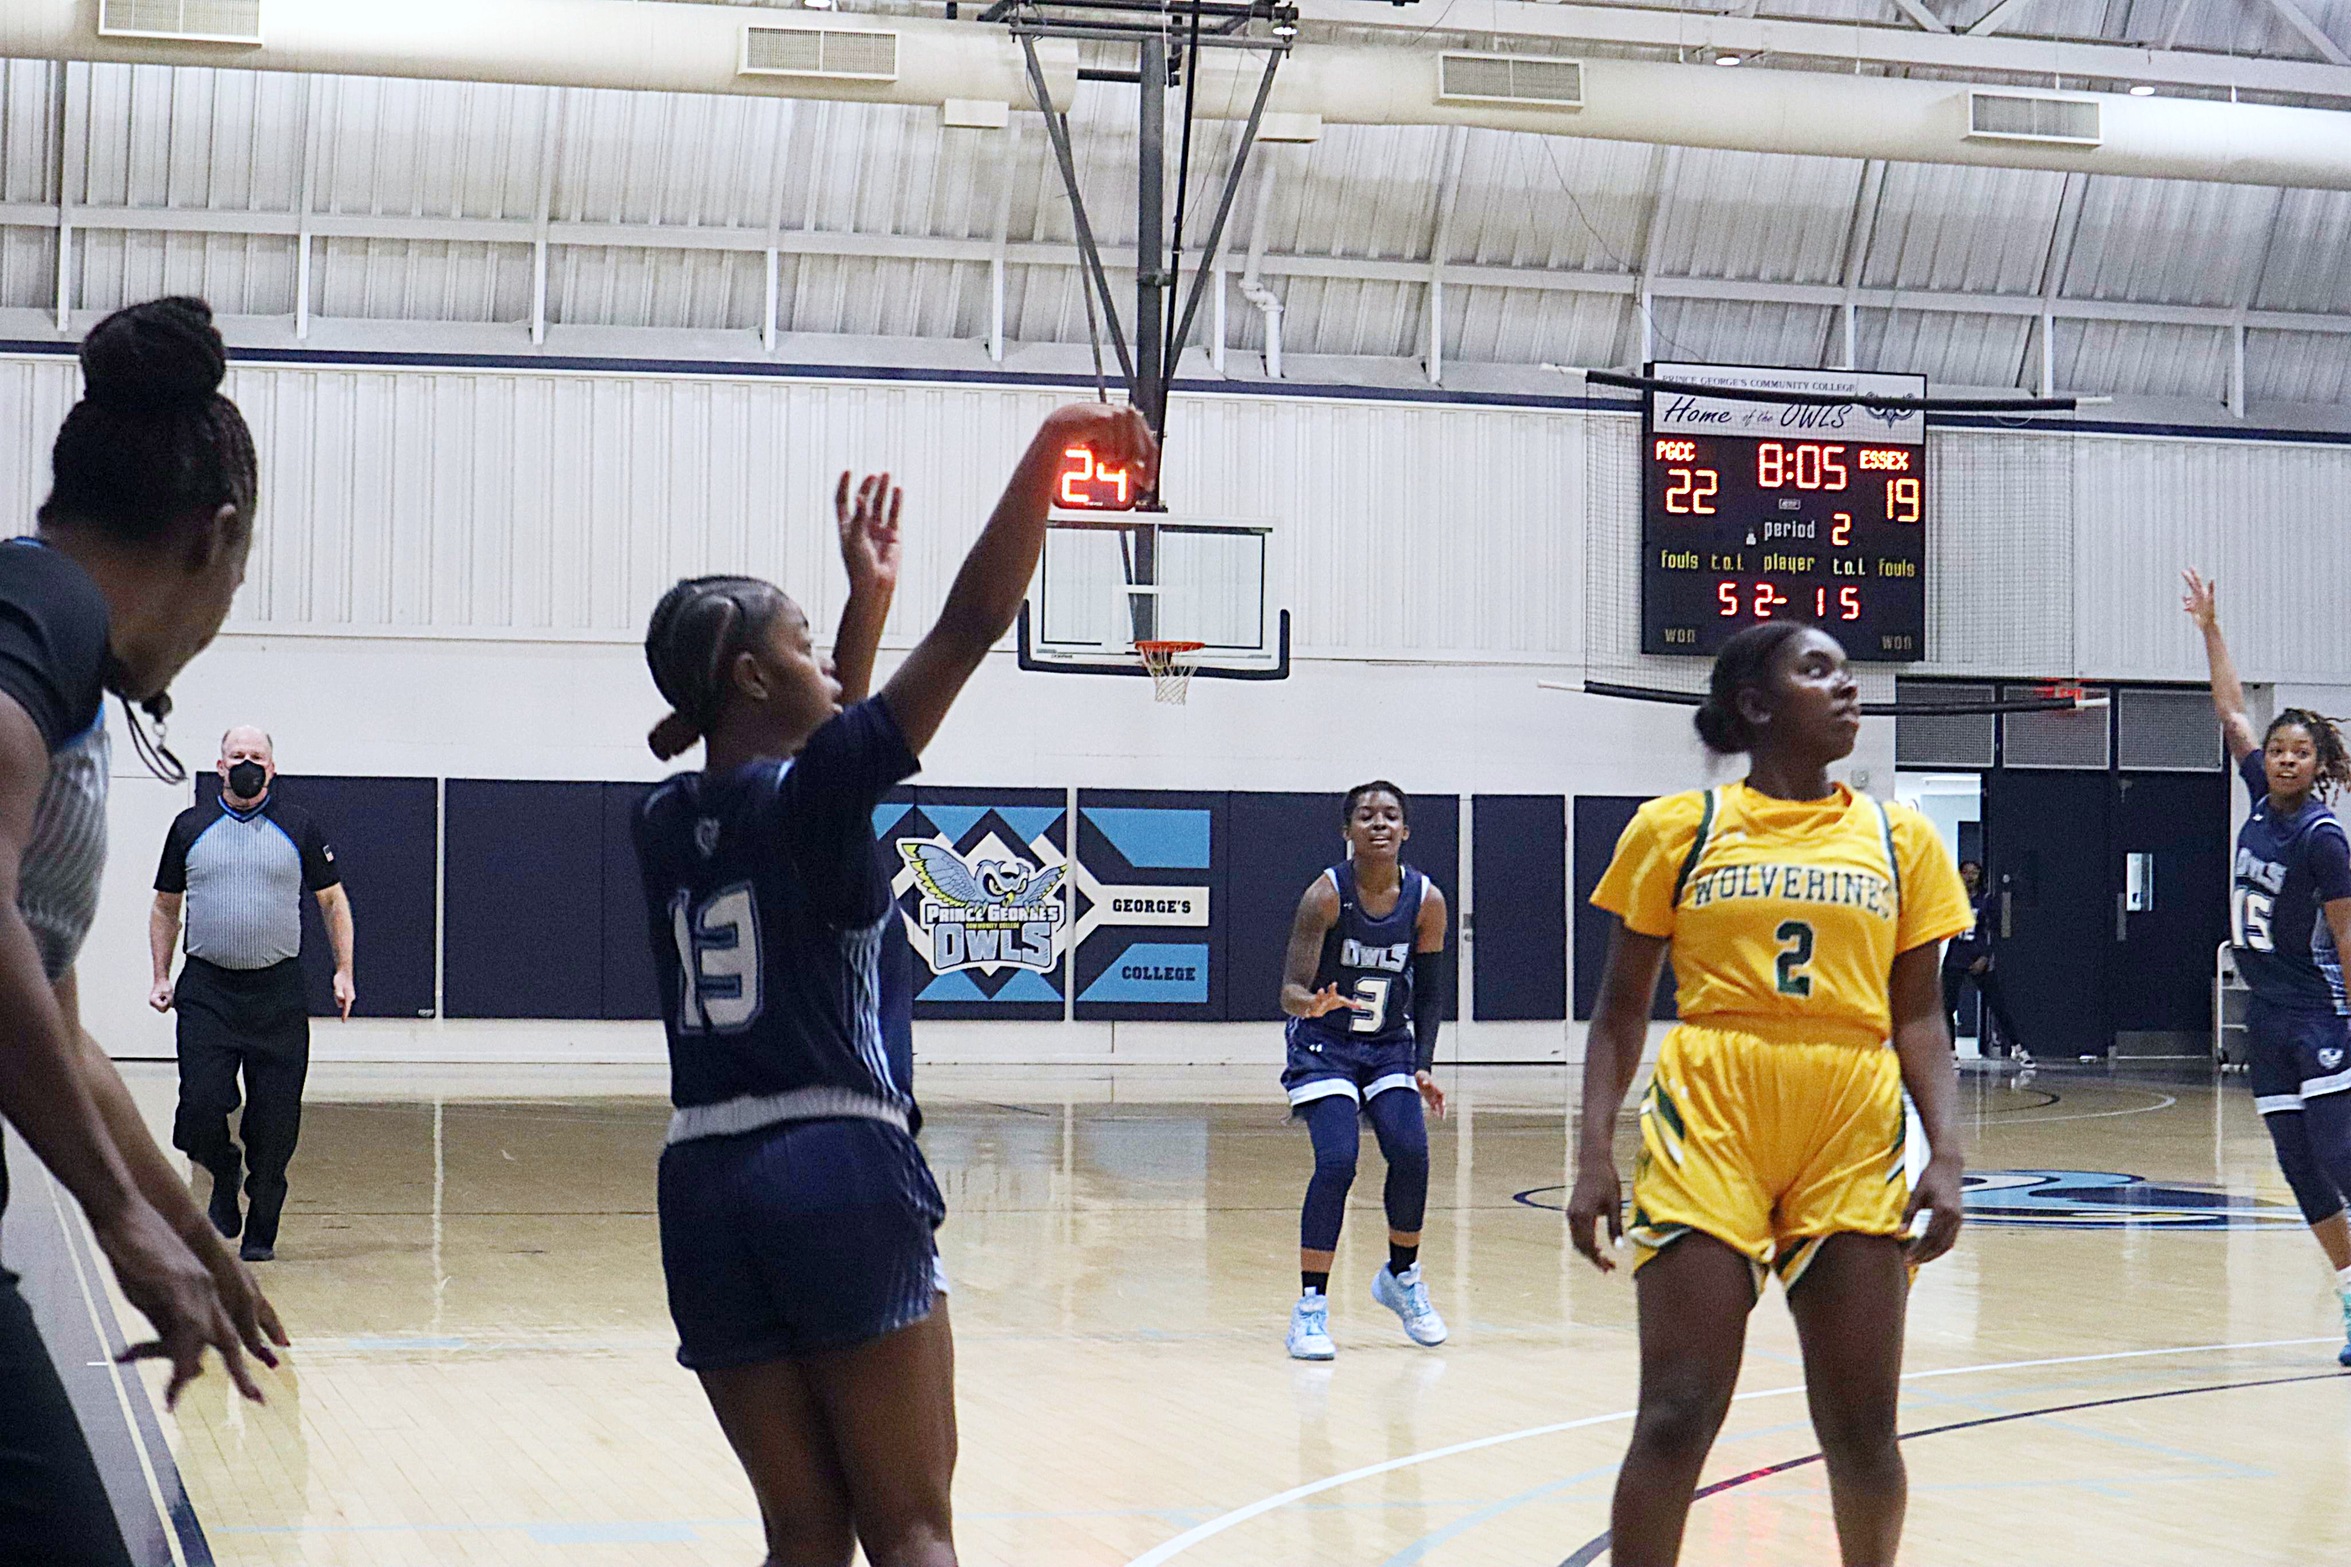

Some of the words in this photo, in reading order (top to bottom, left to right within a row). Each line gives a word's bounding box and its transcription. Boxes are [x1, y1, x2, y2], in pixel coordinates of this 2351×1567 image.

[1662, 375, 1697, 385] PRINCE
[1750, 379, 1809, 390] COMMUNITY
[1812, 382, 1855, 392] COLLEGE
[1663, 396, 1732, 424] Home
[1741, 409, 1755, 428] of
[1757, 411, 1773, 422] the
[1779, 403, 1854, 429] OWLS
[1655, 440, 1696, 462] PGCC
[1758, 443, 1847, 490] 8:05
[1859, 450, 1909, 471] ESSEX
[1061, 449, 1126, 502] 24
[1666, 469, 1718, 514] 22
[1886, 478, 1919, 522] 19
[1764, 520, 1815, 542] period
[1832, 513, 1851, 545] 2
[1661, 550, 1698, 569] fouls
[1763, 553, 1815, 574] player
[1878, 558, 1915, 578] fouls
[1718, 582, 1738, 616] 5
[1816, 587, 1826, 617] 1
[1840, 587, 1860, 620] 5
[1665, 629, 1696, 644] won
[1882, 635, 1912, 650] won
[926, 904, 985, 922] PRINCE
[1112, 899, 1191, 914] GEORGE'S
[2230, 884, 2276, 953] 15
[668, 881, 763, 1035] 13
[934, 922, 1052, 970] OWLS
[1341, 938, 1410, 973] OWLS
[1775, 921, 1813, 997] 2
[1121, 966, 1196, 981] COLLEGE
[1350, 976, 1392, 1034] 3
